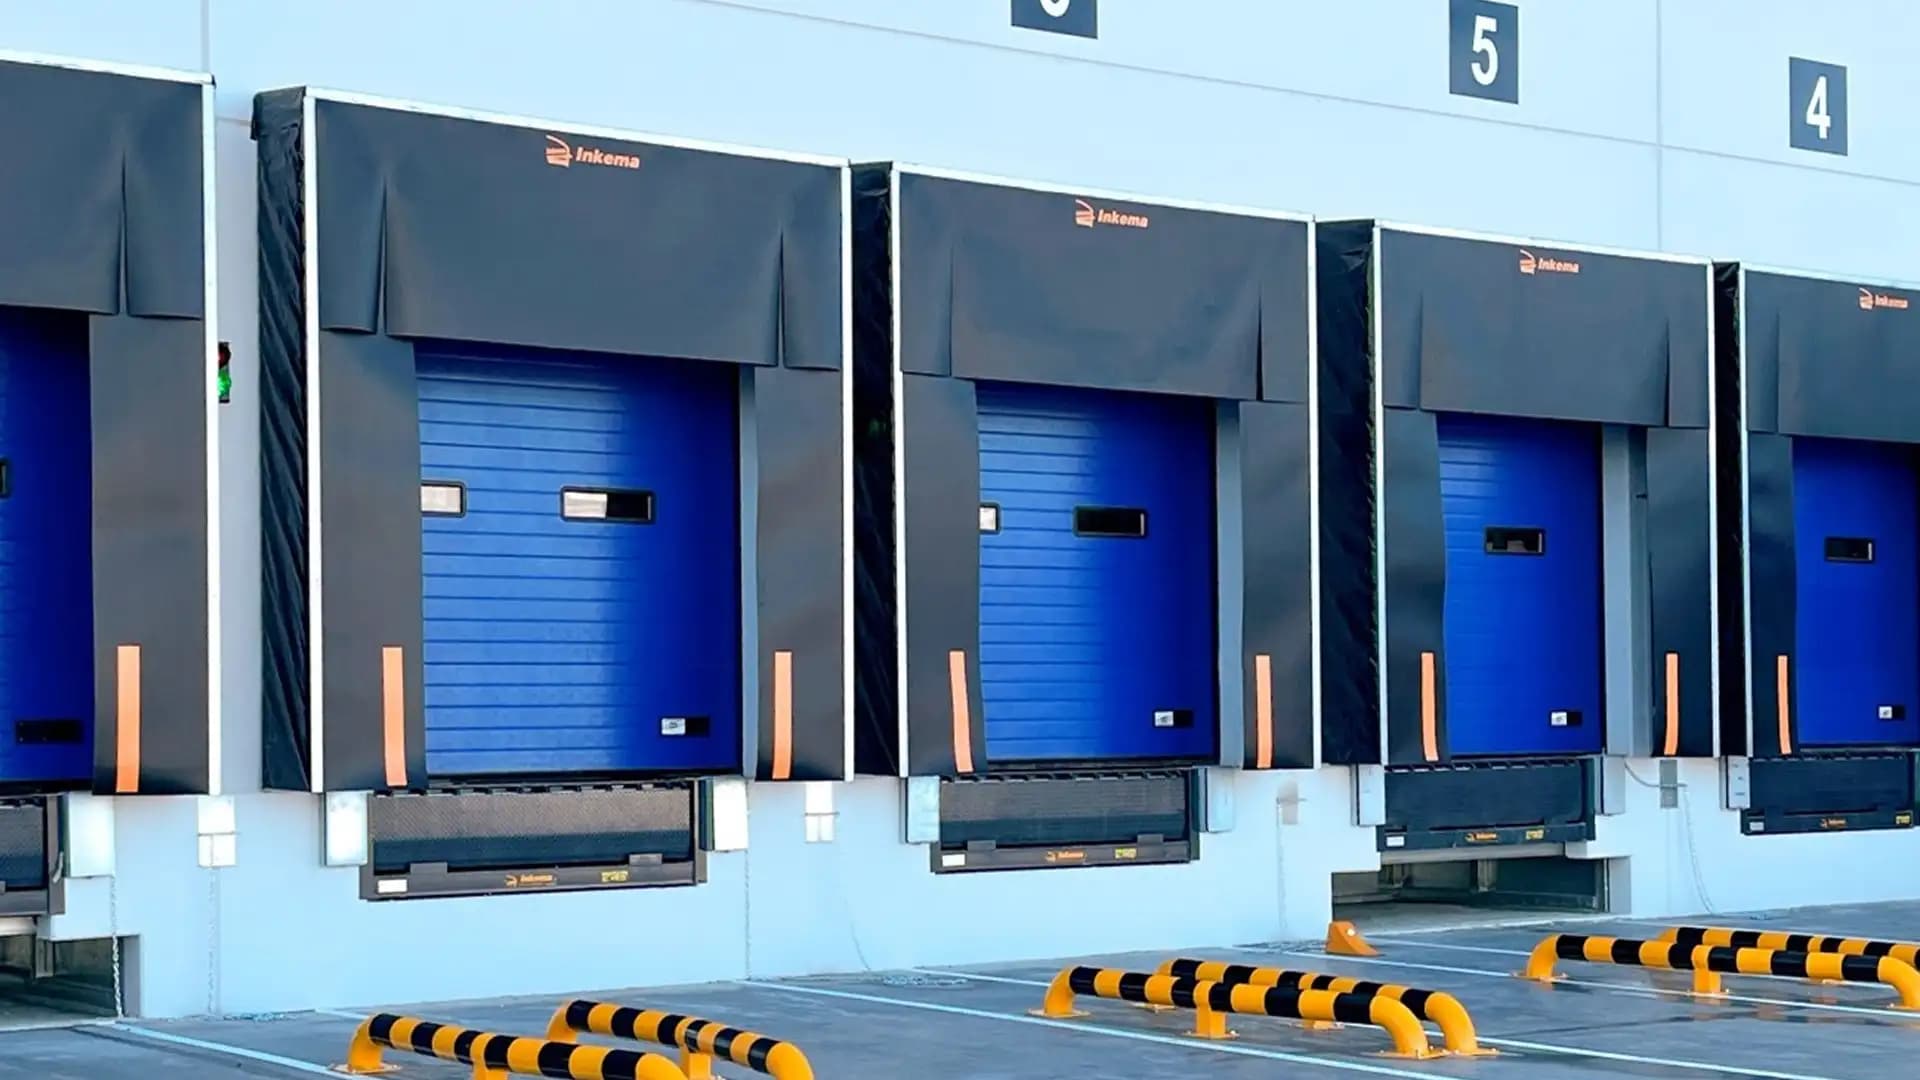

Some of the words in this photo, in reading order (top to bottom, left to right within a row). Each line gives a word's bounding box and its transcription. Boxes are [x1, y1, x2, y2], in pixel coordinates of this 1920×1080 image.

[1471, 15, 1499, 86] 5
[1806, 75, 1832, 139] 4
[576, 146, 641, 170] Inkema
[1097, 209, 1149, 228] Inkema
